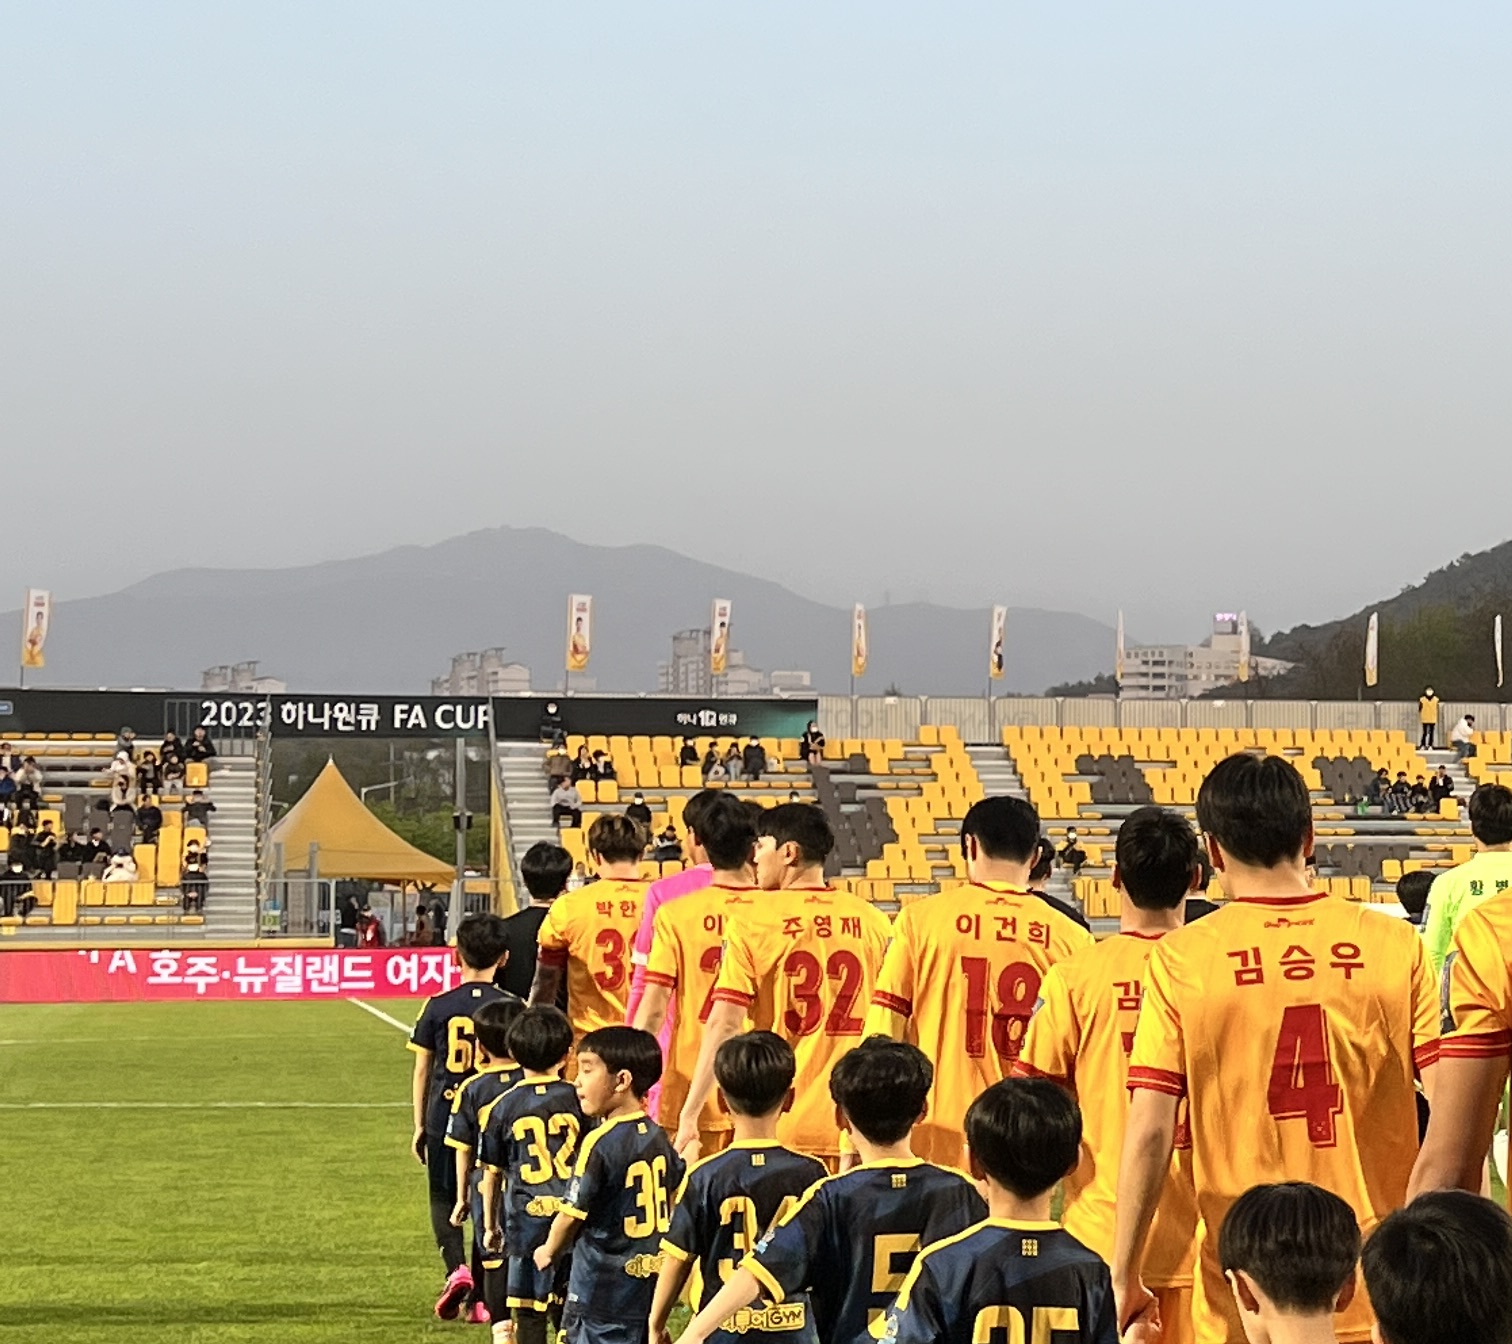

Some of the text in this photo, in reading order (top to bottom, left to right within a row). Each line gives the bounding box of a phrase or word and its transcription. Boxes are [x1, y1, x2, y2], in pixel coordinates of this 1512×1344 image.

[201, 701, 272, 726] 2023
[281, 702, 380, 731] 하나원큐
[394, 704, 427, 729] FA
[956, 913, 1051, 949] 이건희
[1227, 942, 1365, 986] 김승우
[783, 949, 866, 1037] 32
[961, 956, 1043, 1061] 18
[1267, 1003, 1344, 1148] 4
[512, 1112, 580, 1185] 32
[624, 1155, 670, 1238] 36
